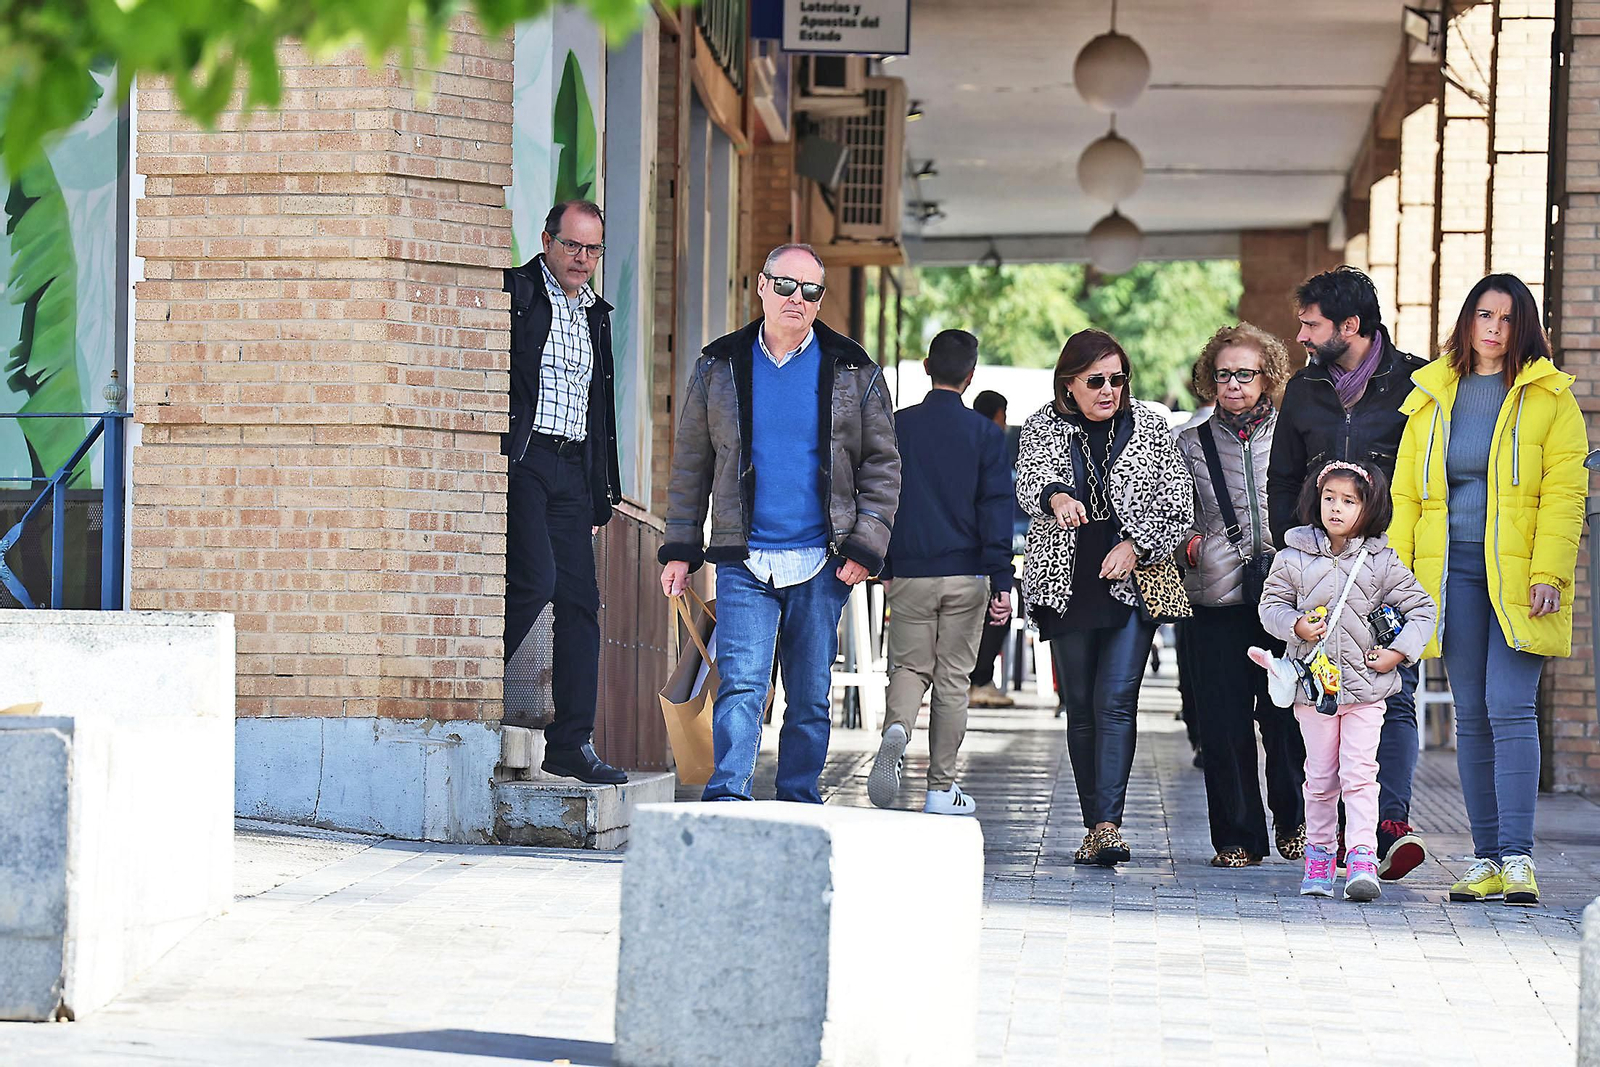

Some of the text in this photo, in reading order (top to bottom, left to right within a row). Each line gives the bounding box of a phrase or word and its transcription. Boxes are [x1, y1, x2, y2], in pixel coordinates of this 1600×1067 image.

[853, 4, 862, 16] y
[800, 16, 880, 29] Apuestas del
[799, 30, 842, 41] Estado
